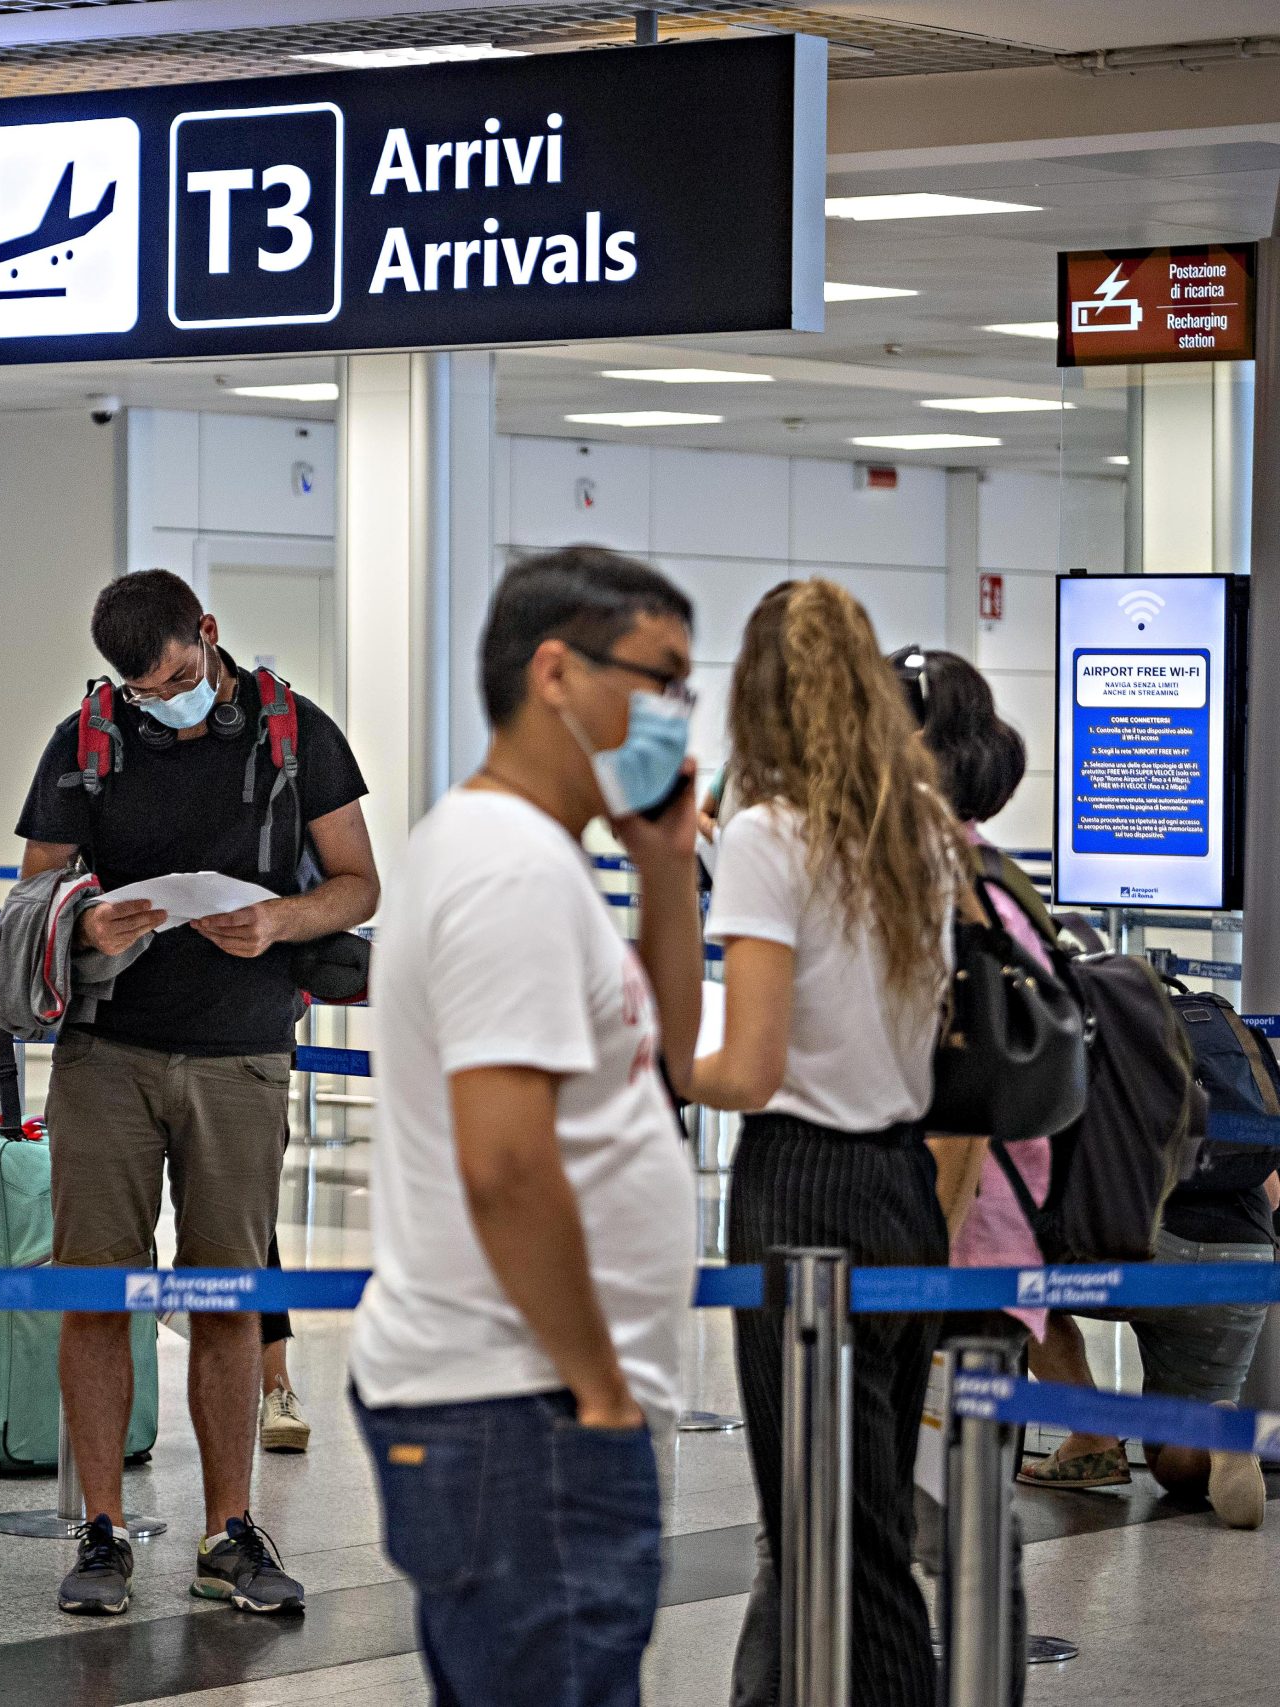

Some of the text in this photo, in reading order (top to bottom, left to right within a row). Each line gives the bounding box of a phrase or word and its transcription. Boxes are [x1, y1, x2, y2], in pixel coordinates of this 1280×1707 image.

[369, 112, 562, 195] Arrivi
[186, 164, 313, 274] T3
[368, 211, 638, 294] Arrivals
[1169, 262, 1226, 279] Postazione
[1171, 282, 1224, 299] di ricarica
[1167, 313, 1227, 330] Recharging
[1178, 332, 1215, 349] station
[1083, 666, 1200, 677] AIRPORT FREE WI-FI
[1131, 886, 1158, 894] Aeroporti
[162, 1275, 254, 1293] Aeroporti
[161, 1292, 238, 1310] di Roma
